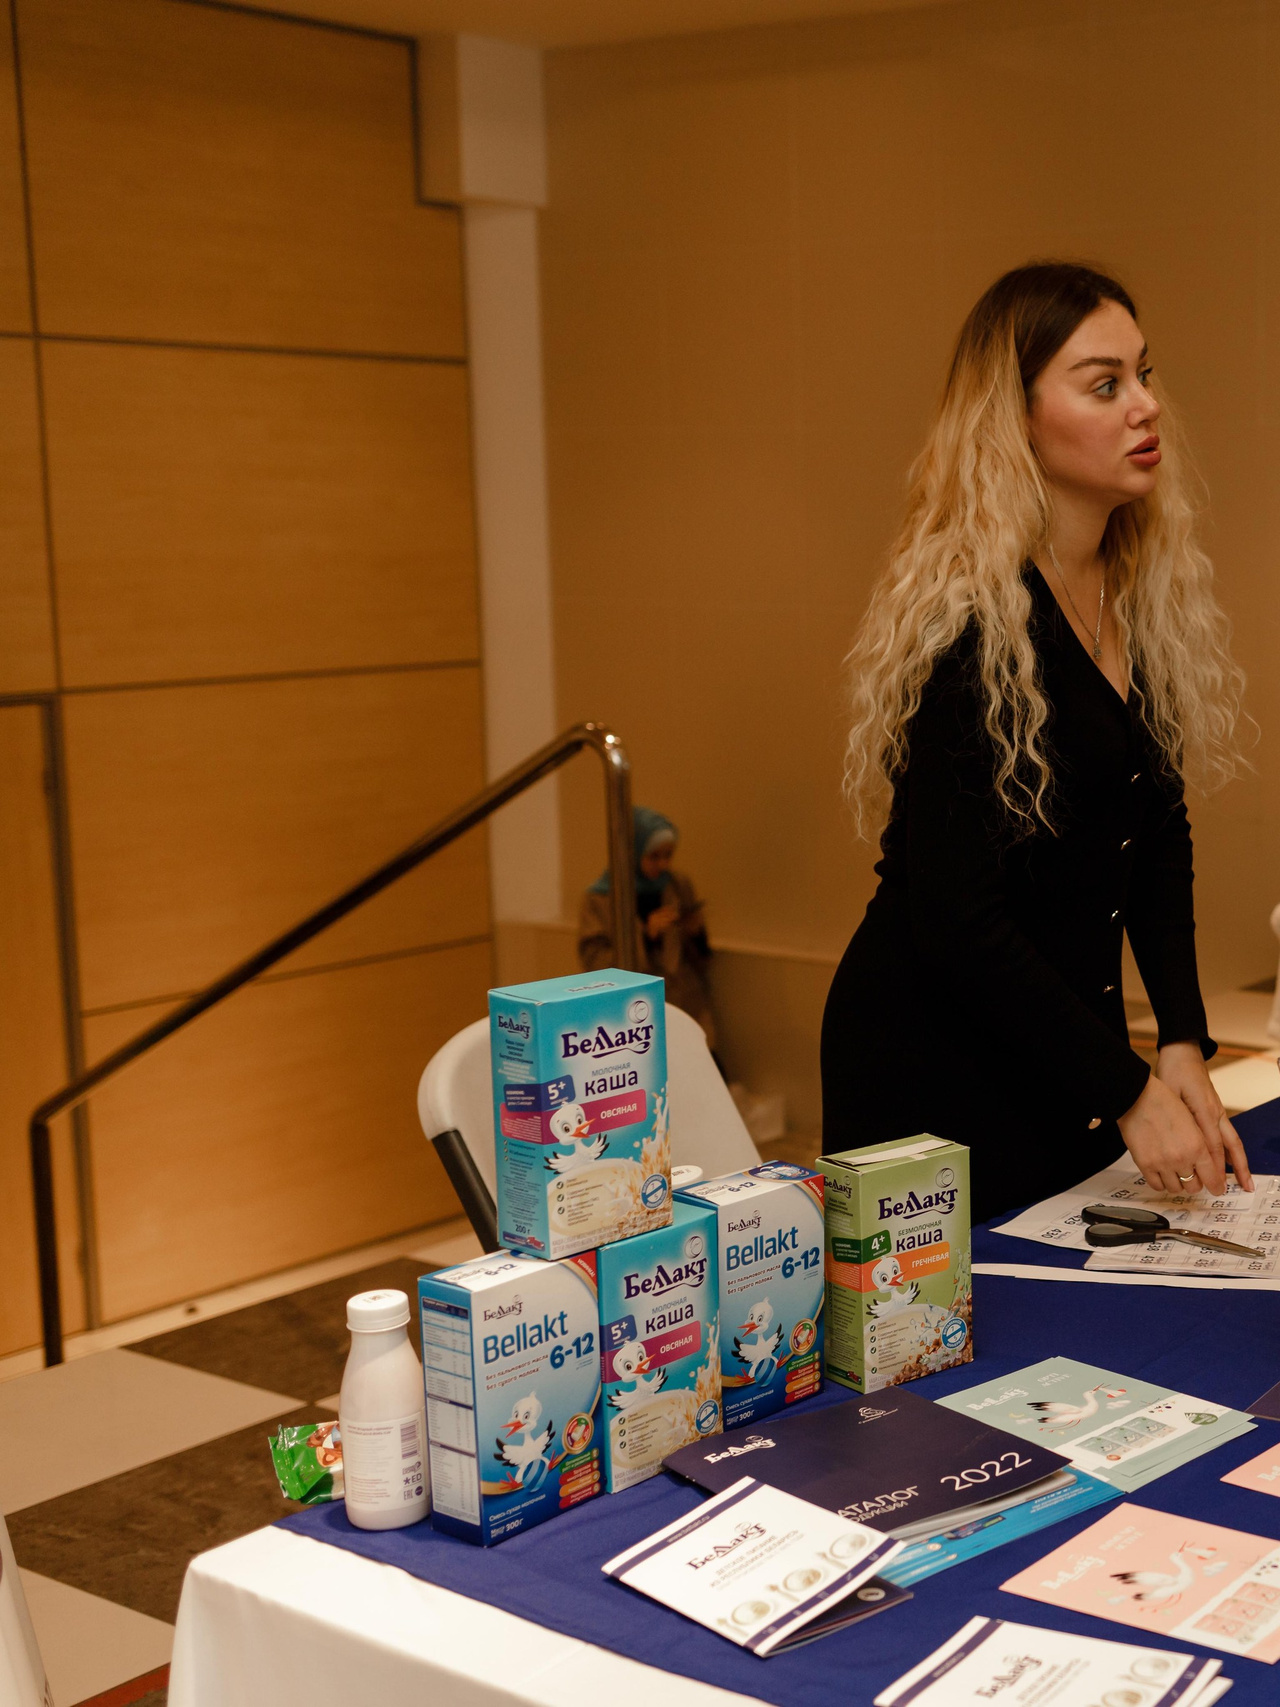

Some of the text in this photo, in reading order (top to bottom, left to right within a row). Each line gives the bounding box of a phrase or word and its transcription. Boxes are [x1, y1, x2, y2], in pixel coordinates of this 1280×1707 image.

[591, 1062, 631, 1077] МОЛОЧНАЯ
[548, 1081, 566, 1100] 5+
[584, 1070, 638, 1097] каша
[600, 1103, 637, 1120] ОВСЯНАЯ
[898, 1220, 942, 1237] БЕЗМОЛОЧНАЯ
[726, 1226, 799, 1272] Bellakt
[871, 1234, 886, 1250] 4+
[896, 1228, 943, 1253] каша
[781, 1246, 820, 1279] 6-12
[911, 1251, 950, 1268] ГРЕЧНЕВАЯ
[651, 1296, 688, 1315] МОЛОЧНАЯ
[645, 1303, 694, 1335] каша
[483, 1310, 569, 1365] Bellakt
[611, 1321, 628, 1341] 5+
[550, 1332, 595, 1370] 6-12
[660, 1334, 693, 1354] ОВСЯНАЯ
[939, 1451, 1033, 1492] 2022
[838, 1485, 919, 1517] АТАЛОГ
[850, 1500, 909, 1523] ОДУКЦИИ
